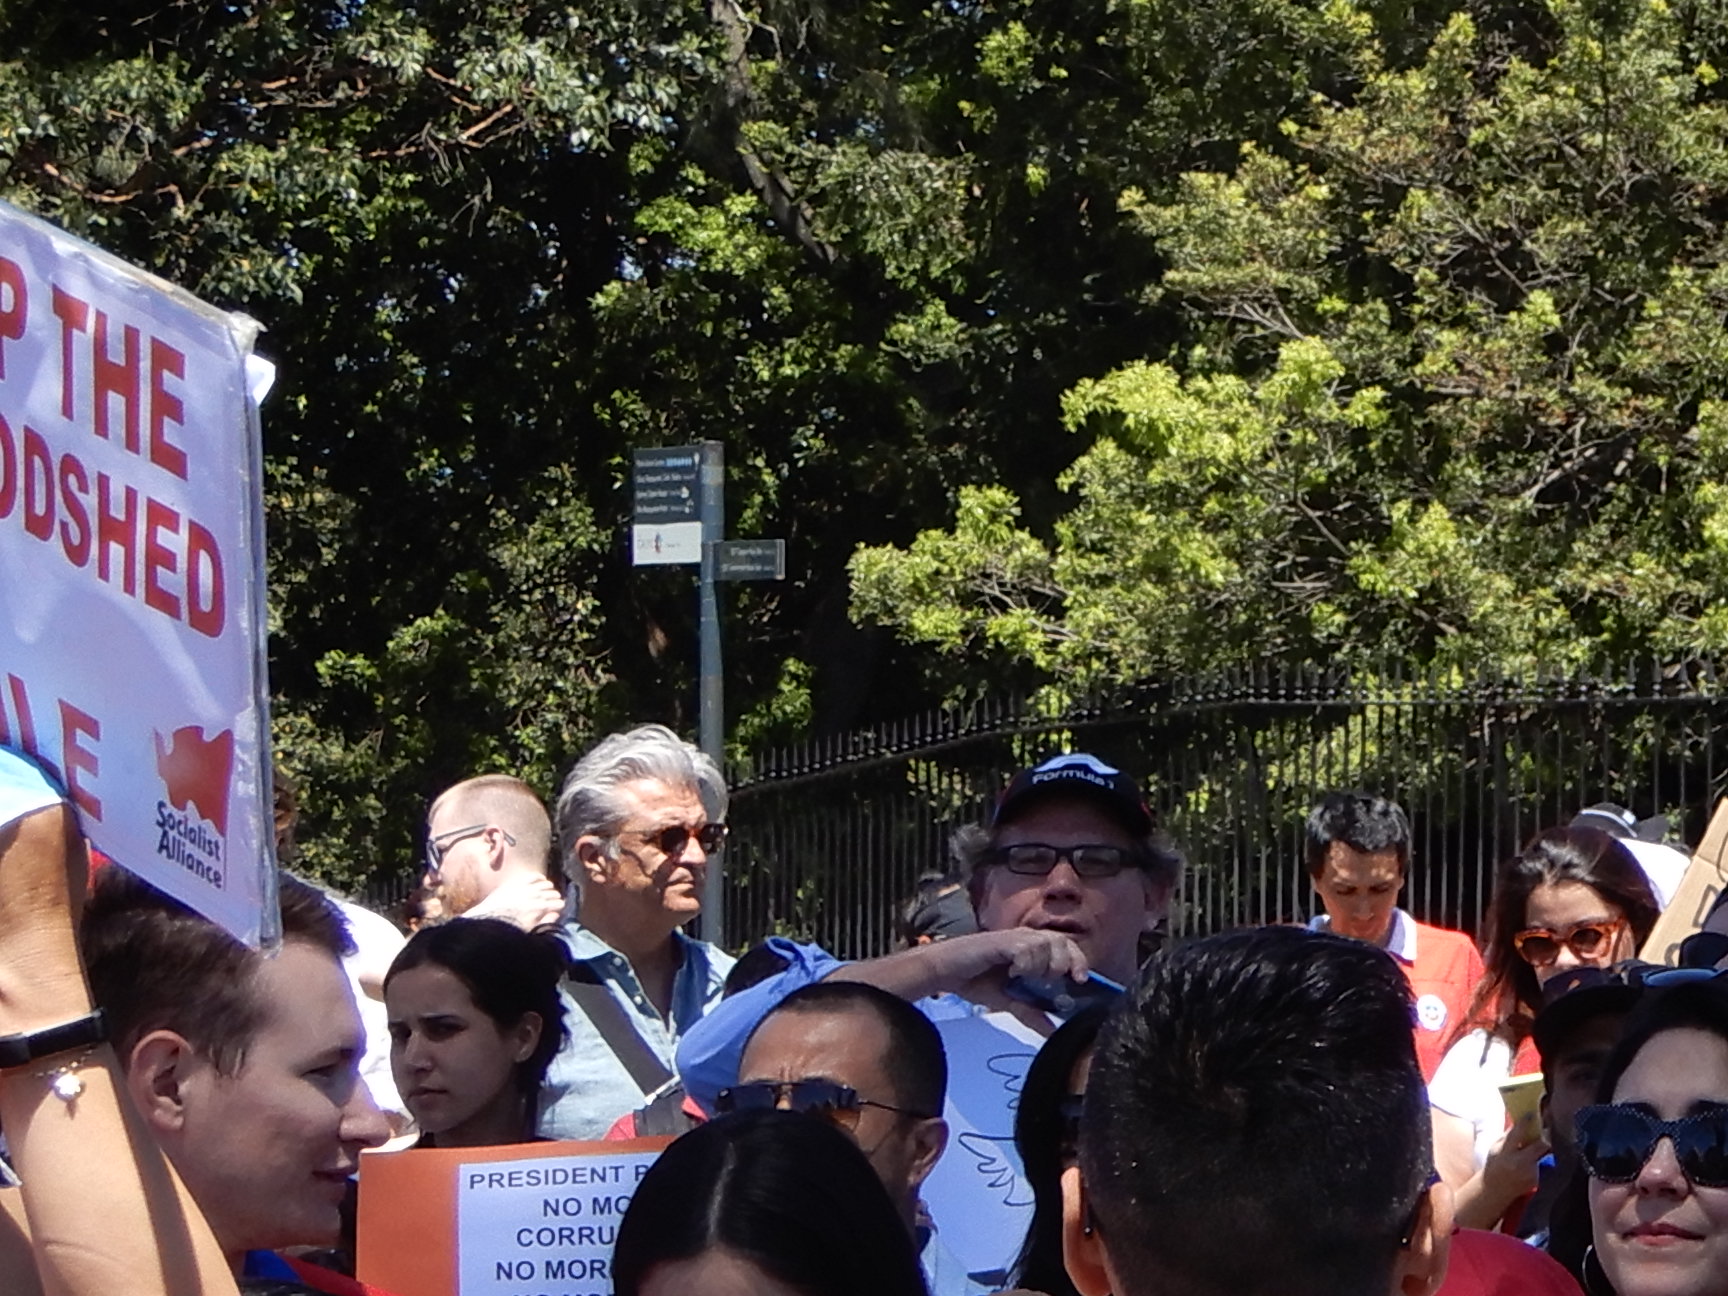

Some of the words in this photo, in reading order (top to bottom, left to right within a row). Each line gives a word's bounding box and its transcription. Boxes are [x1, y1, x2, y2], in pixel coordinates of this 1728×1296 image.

[52, 283, 188, 483] THE
[156, 800, 221, 861] Socialist
[157, 829, 222, 889] Alliance
[469, 1165, 625, 1190] PRESIDENT
[542, 1196, 582, 1217] NO
[592, 1195, 632, 1216] MO
[516, 1226, 615, 1248] CORRU
[495, 1260, 535, 1282] NO
[545, 1258, 607, 1281] MOR
